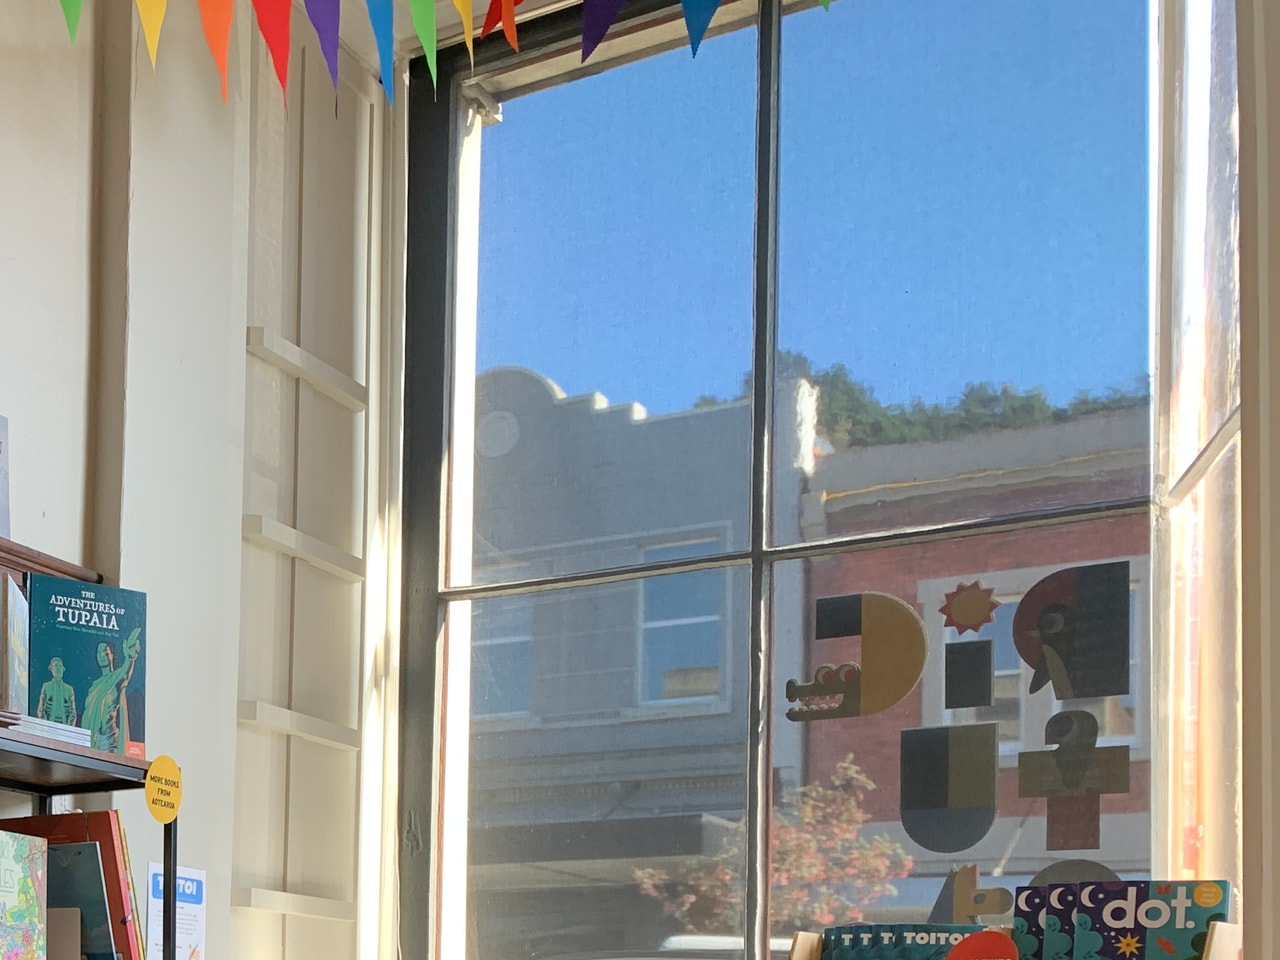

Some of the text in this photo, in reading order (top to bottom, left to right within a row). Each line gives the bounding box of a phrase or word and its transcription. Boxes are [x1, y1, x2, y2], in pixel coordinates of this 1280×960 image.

[81, 590, 96, 599] THE
[50, 594, 115, 614] ADVENTURES
[55, 606, 120, 631] TUPAIA
[150, 774, 180, 788] MORE BOOKS
[157, 788, 171, 797] FROM
[151, 798, 176, 810] AOTEAROA
[1102, 886, 1196, 930] dot.
